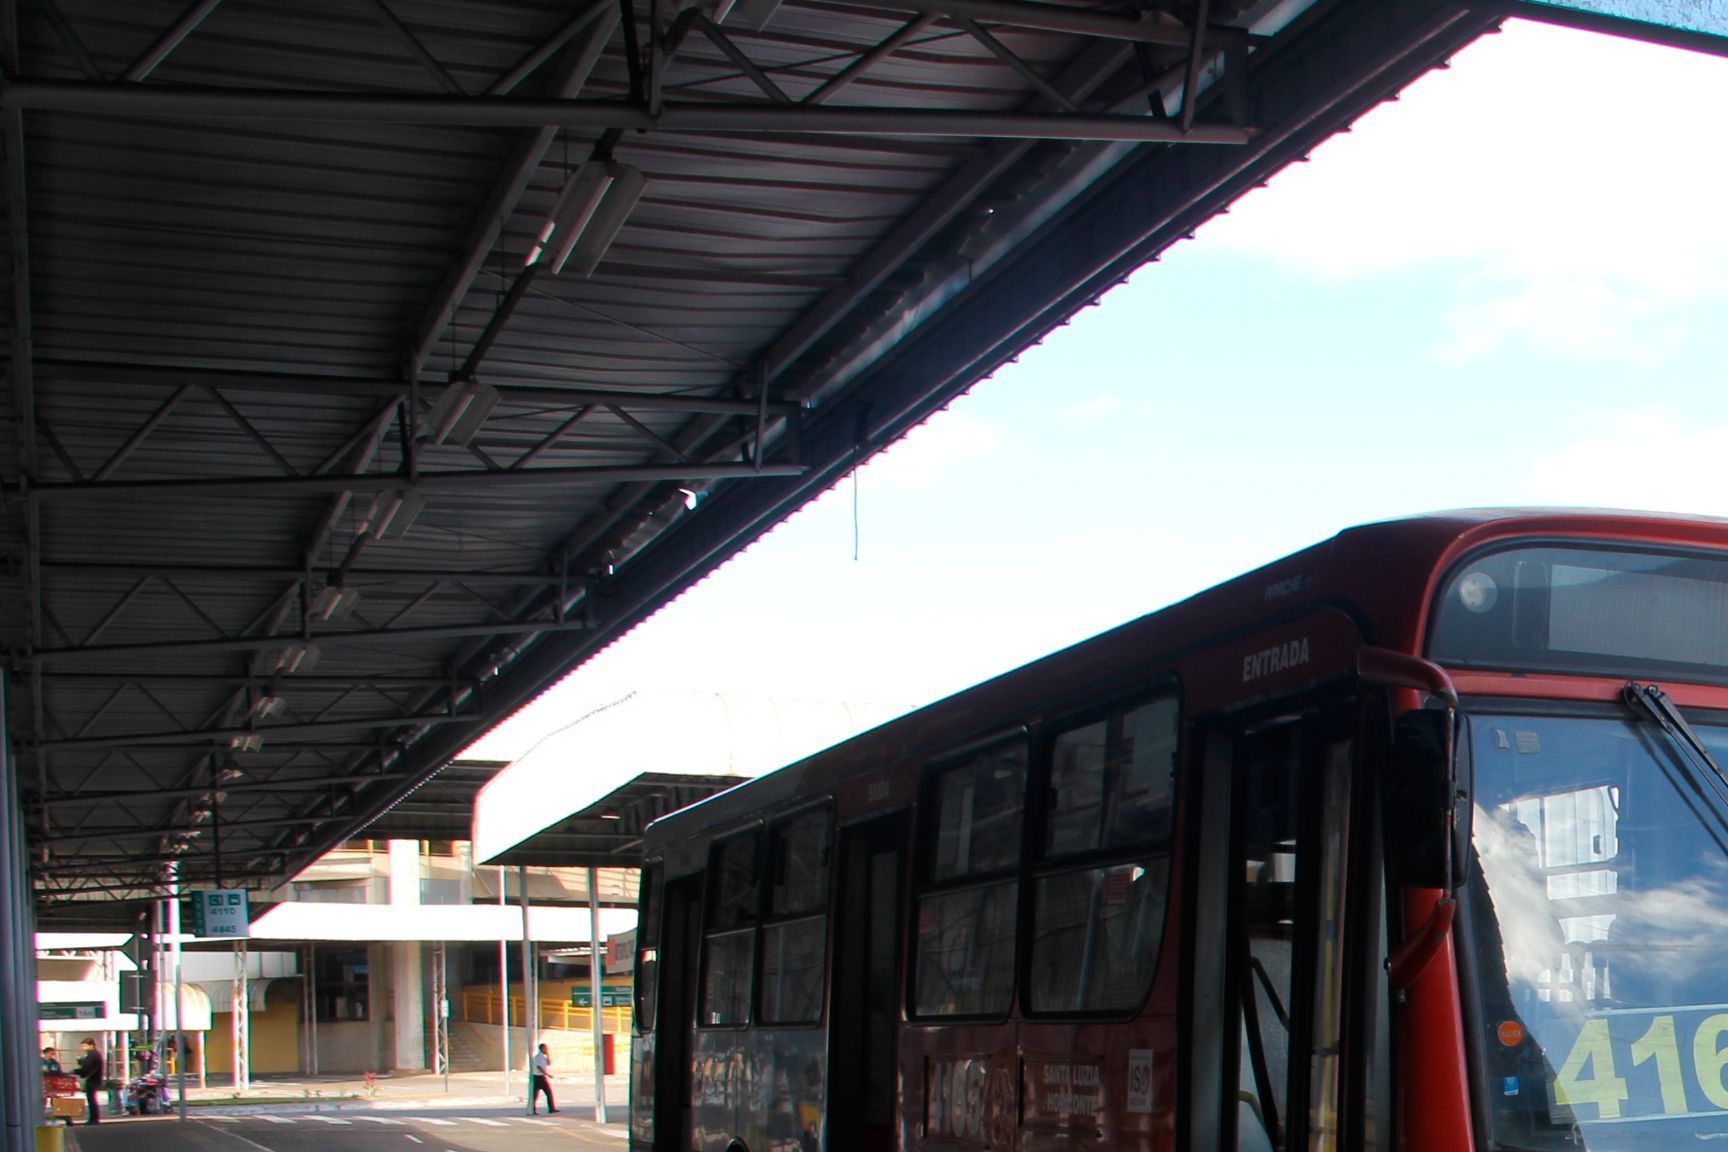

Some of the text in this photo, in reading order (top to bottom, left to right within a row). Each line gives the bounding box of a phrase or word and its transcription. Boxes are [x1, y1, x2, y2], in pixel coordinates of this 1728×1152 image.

[1242, 637, 1310, 682] ENTRADA
[1044, 1064, 1100, 1087] SANTA LUZIA
